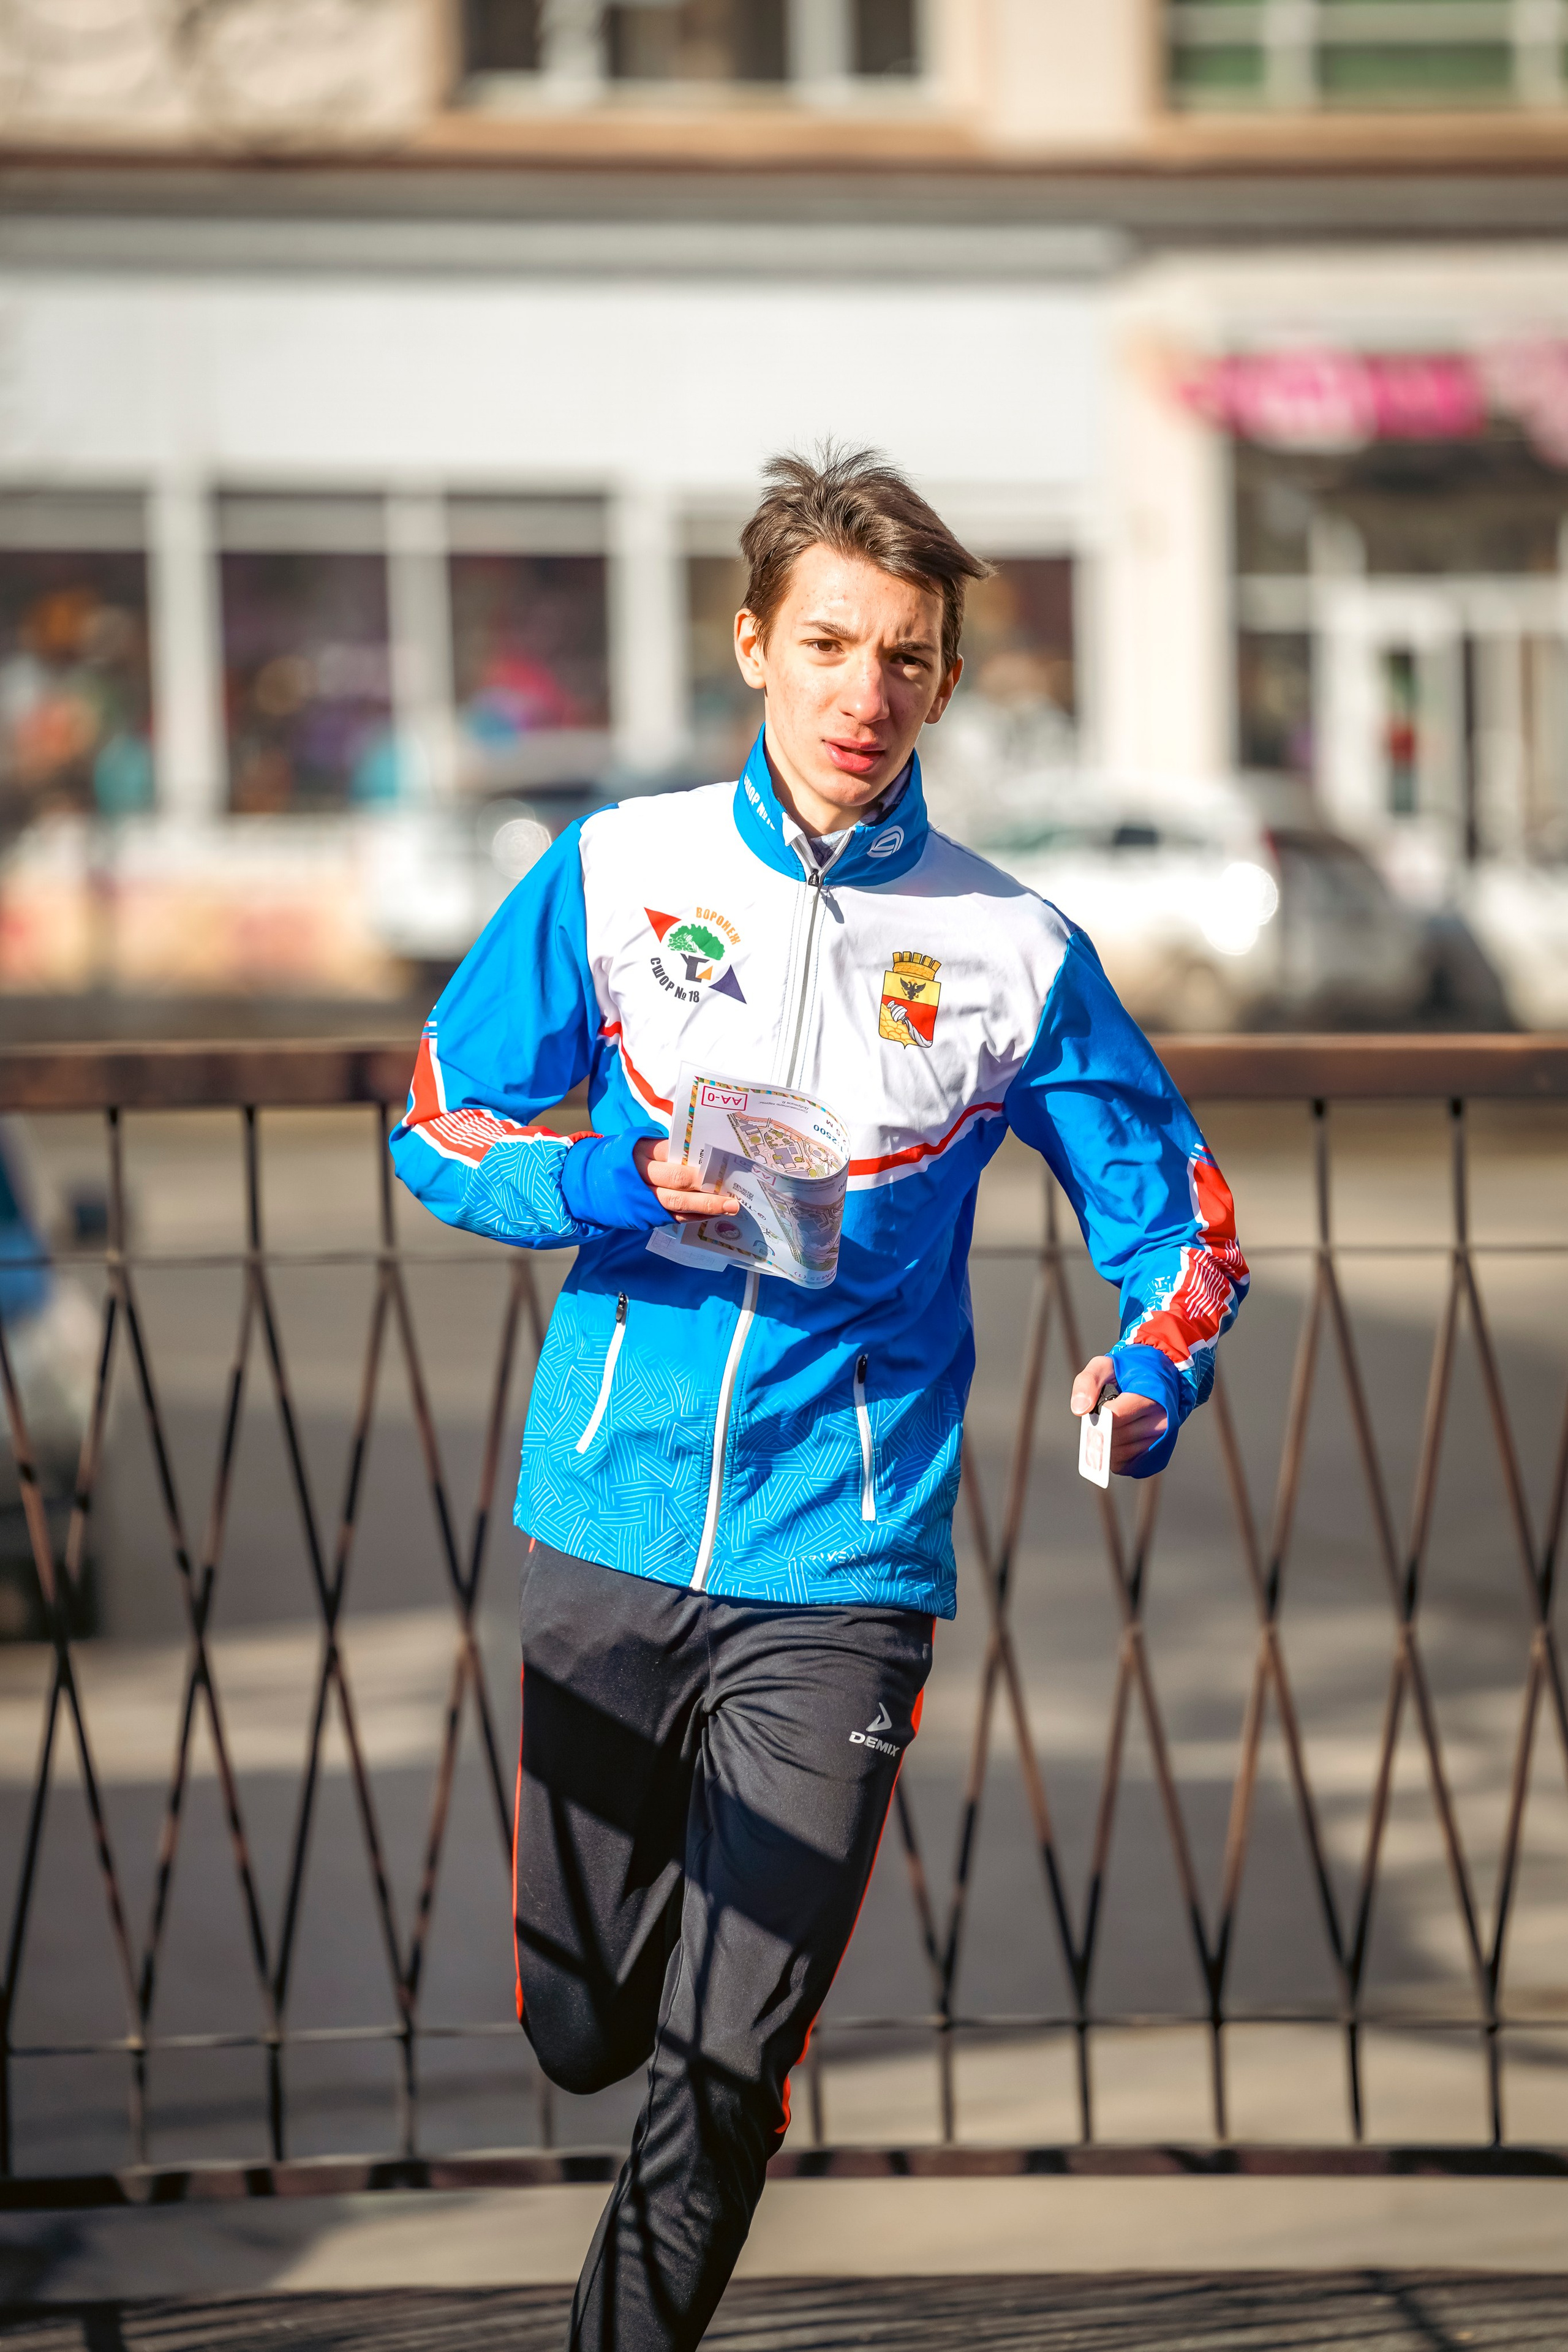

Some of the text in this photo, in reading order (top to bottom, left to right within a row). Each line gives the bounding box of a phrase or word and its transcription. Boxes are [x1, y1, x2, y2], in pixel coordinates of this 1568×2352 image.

[696, 907, 741, 945] ВОРОНЕЖ
[650, 957, 700, 1003] СШОР № 18
[848, 1731, 900, 1757] DEMIX
